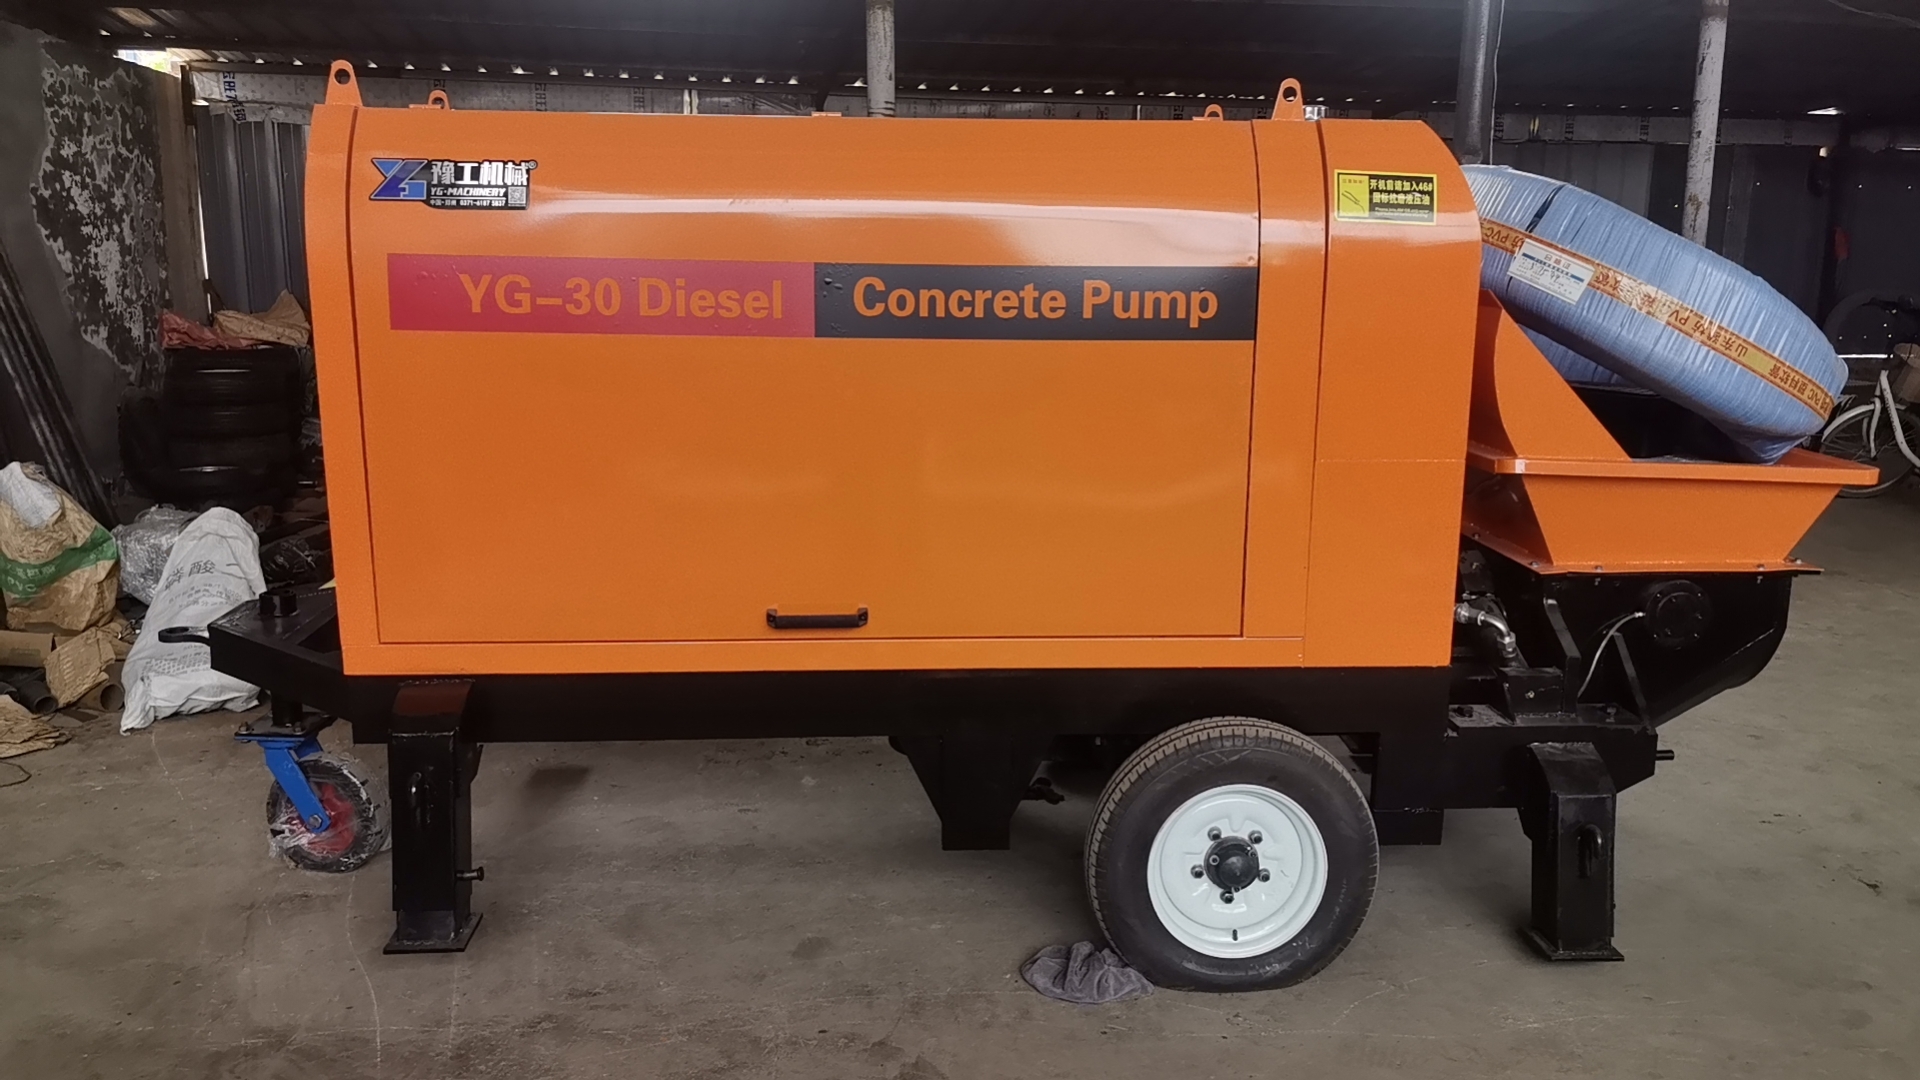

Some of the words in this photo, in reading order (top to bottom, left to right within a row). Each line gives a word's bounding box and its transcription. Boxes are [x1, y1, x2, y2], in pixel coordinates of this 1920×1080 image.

[1485, 226, 1510, 243] PVC
[459, 273, 621, 317] YG-30
[639, 276, 783, 319] Diesel
[853, 276, 1067, 319] Concrete
[1083, 279, 1219, 328] Pump
